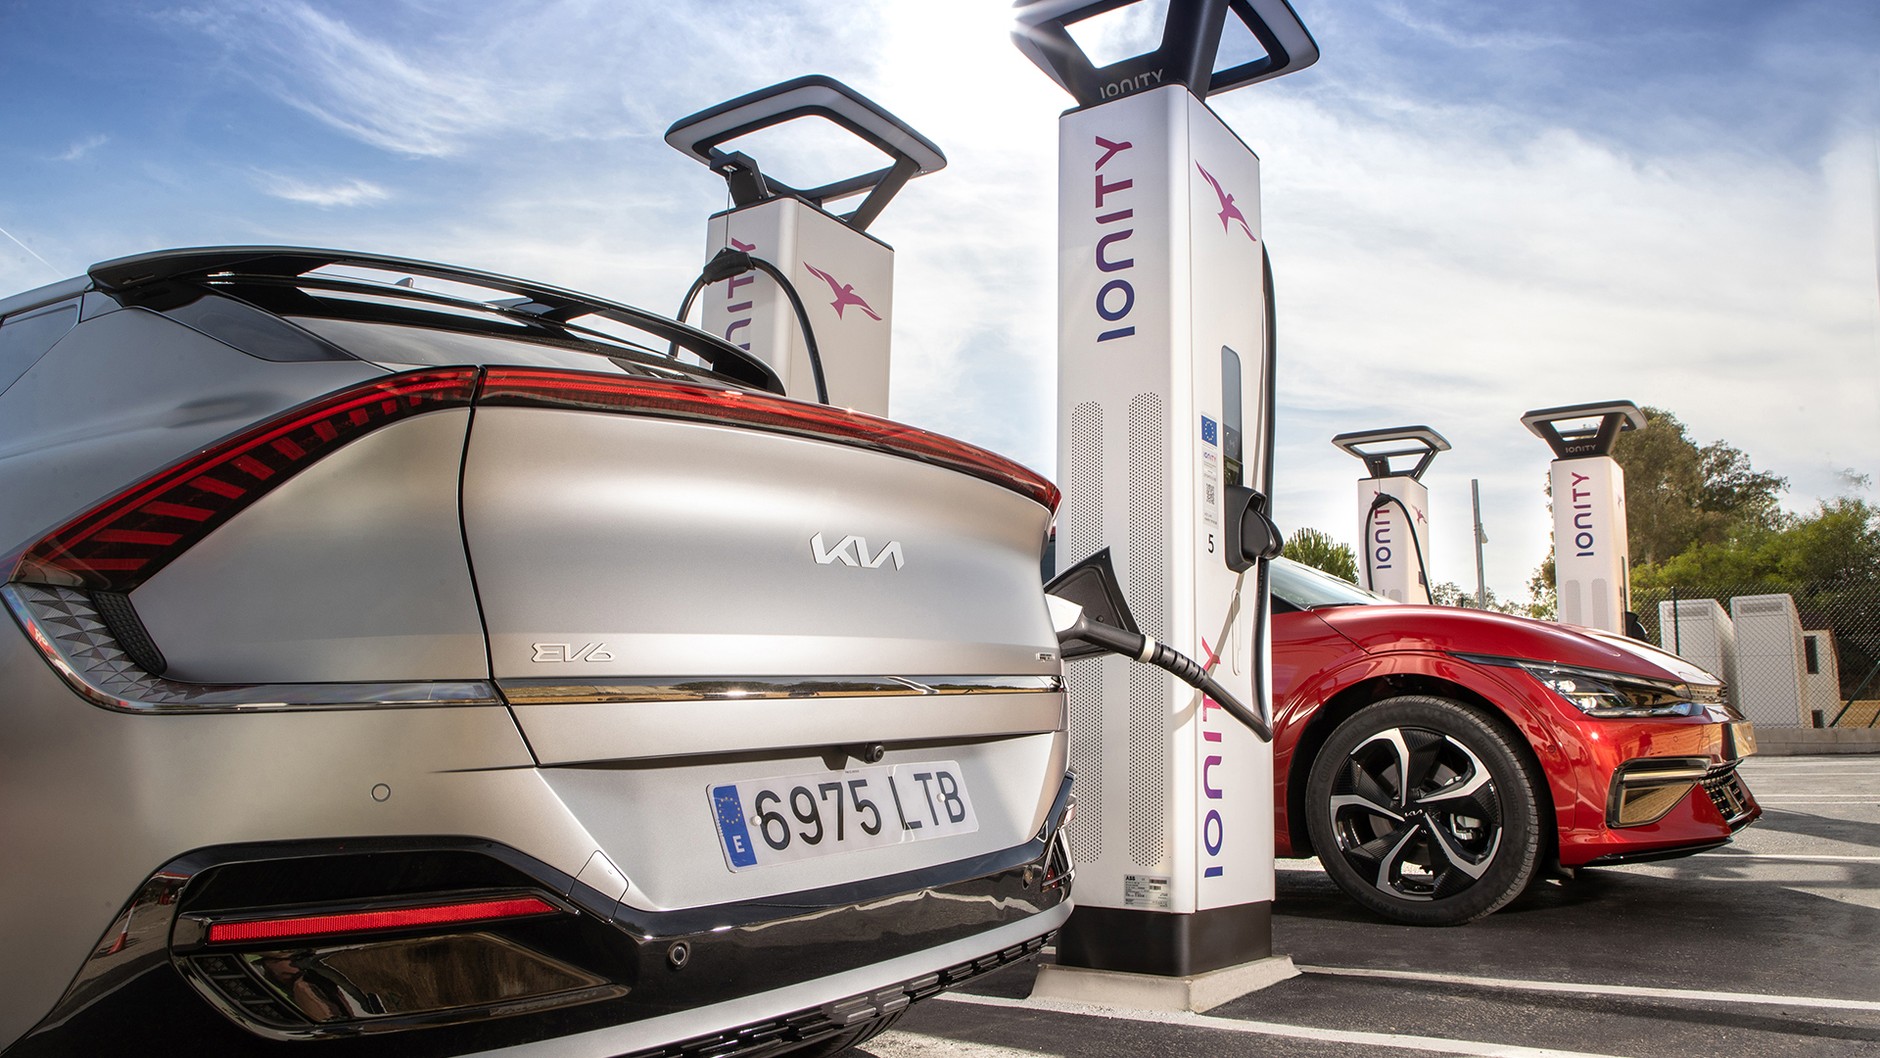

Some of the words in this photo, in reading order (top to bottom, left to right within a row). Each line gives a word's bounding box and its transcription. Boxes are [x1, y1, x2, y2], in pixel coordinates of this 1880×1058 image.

[1099, 69, 1164, 99] IONITY
[1095, 136, 1136, 343] IONITY
[1565, 444, 1597, 454] IONITY
[1374, 490, 1392, 570] IONIT
[1572, 471, 1594, 557] IONITY
[810, 531, 904, 571] KIA
[1207, 534, 1215, 554] 5
[531, 642, 616, 663] EV6
[755, 776, 882, 851] 6975
[888, 770, 967, 831] LTB
[732, 834, 745, 853] E
